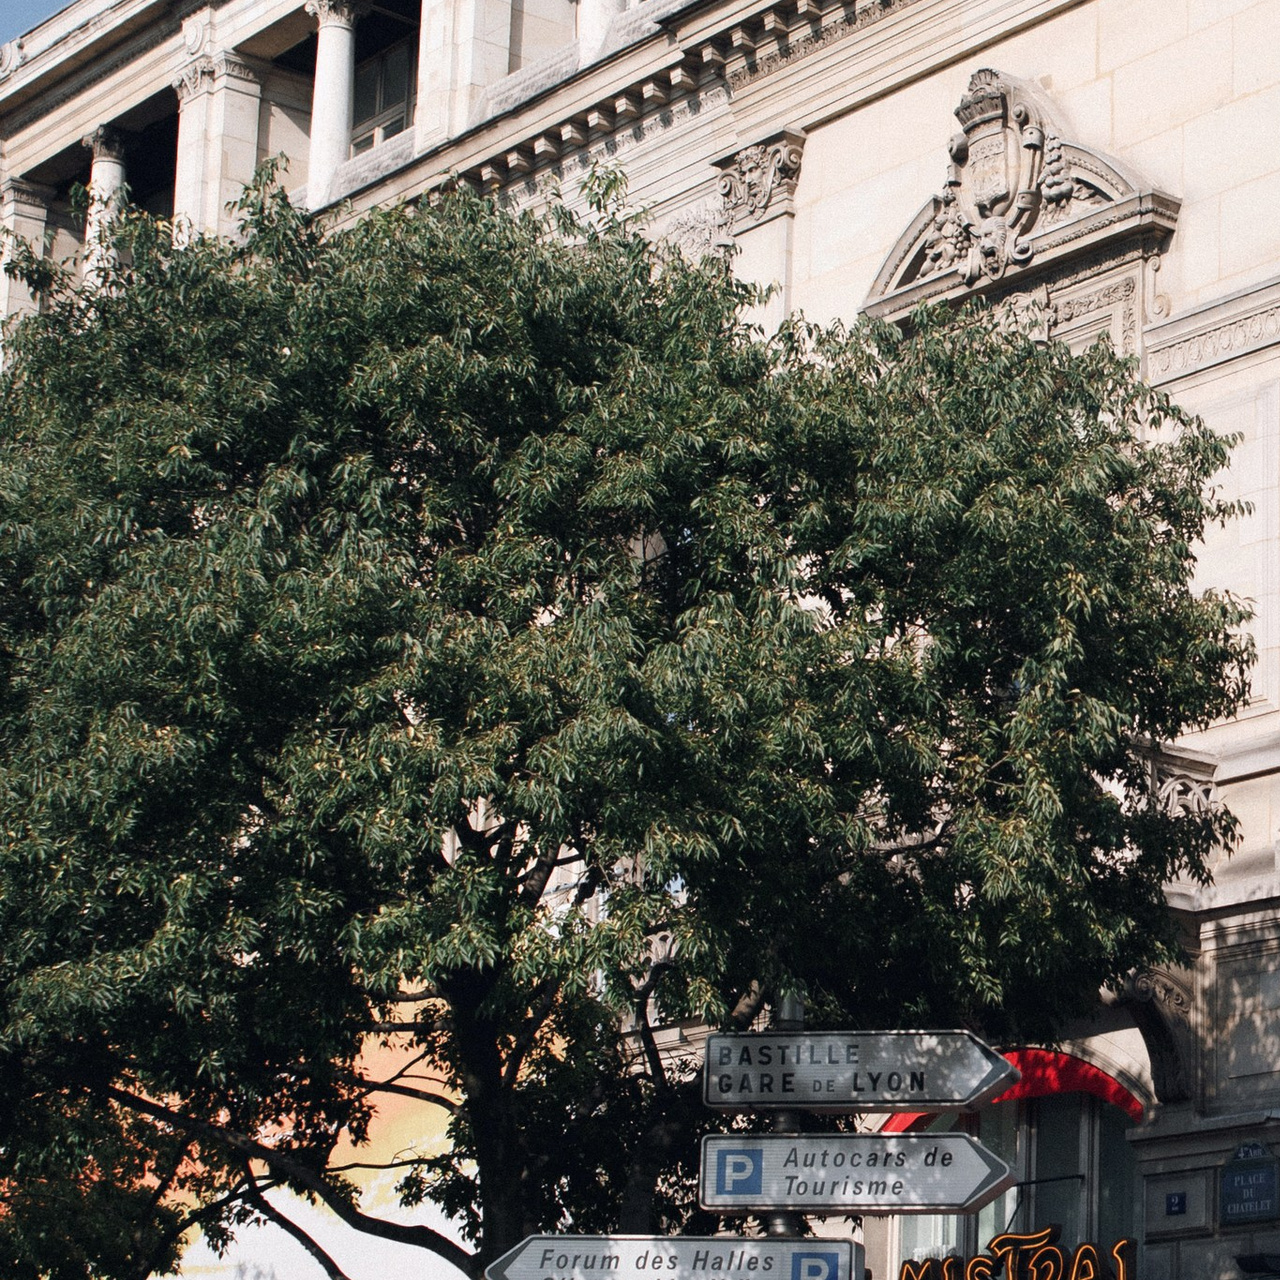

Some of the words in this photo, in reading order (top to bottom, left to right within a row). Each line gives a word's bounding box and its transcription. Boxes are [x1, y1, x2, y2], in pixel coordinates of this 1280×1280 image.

[718, 1044, 859, 1066] BASTILLE
[718, 1072, 795, 1094] GARE
[812, 1079, 835, 1093] DE
[853, 1071, 925, 1092] LYON
[783, 1147, 906, 1168] Autocars
[923, 1146, 953, 1168] de
[785, 1176, 904, 1196] Tourisme
[1234, 1173, 1265, 1186] PLACE
[1171, 1196, 1180, 1211] 2
[1243, 1188, 1254, 1199] DU
[539, 1249, 620, 1271] Forum
[635, 1250, 679, 1271] des
[692, 1250, 774, 1271] Halles
